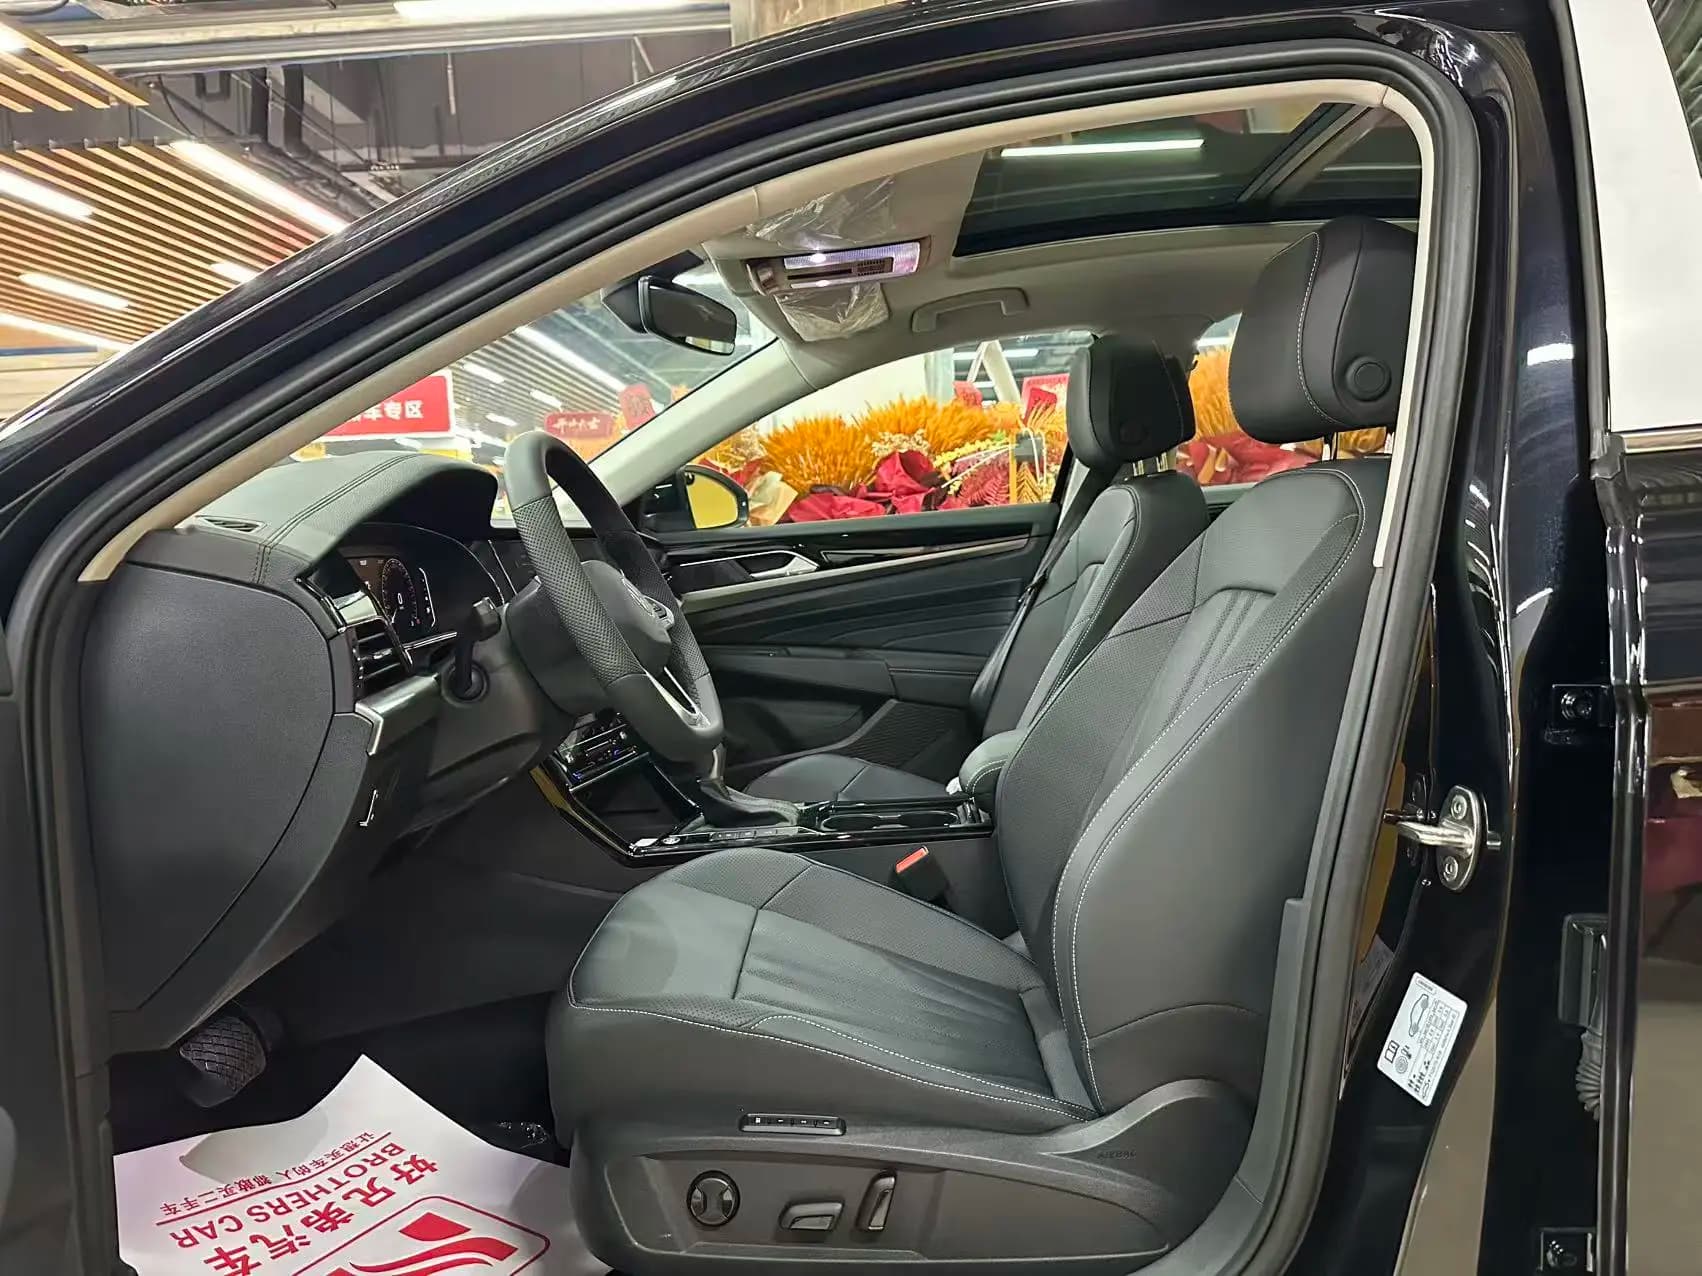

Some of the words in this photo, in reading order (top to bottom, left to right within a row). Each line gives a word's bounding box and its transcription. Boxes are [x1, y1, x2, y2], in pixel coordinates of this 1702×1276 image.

[350, 399, 424, 422] 车专区
[246, 1142, 406, 1224] BROTHERS
[169, 1214, 245, 1249] CAR
[203, 1154, 439, 1276] 好兄弟汽车
